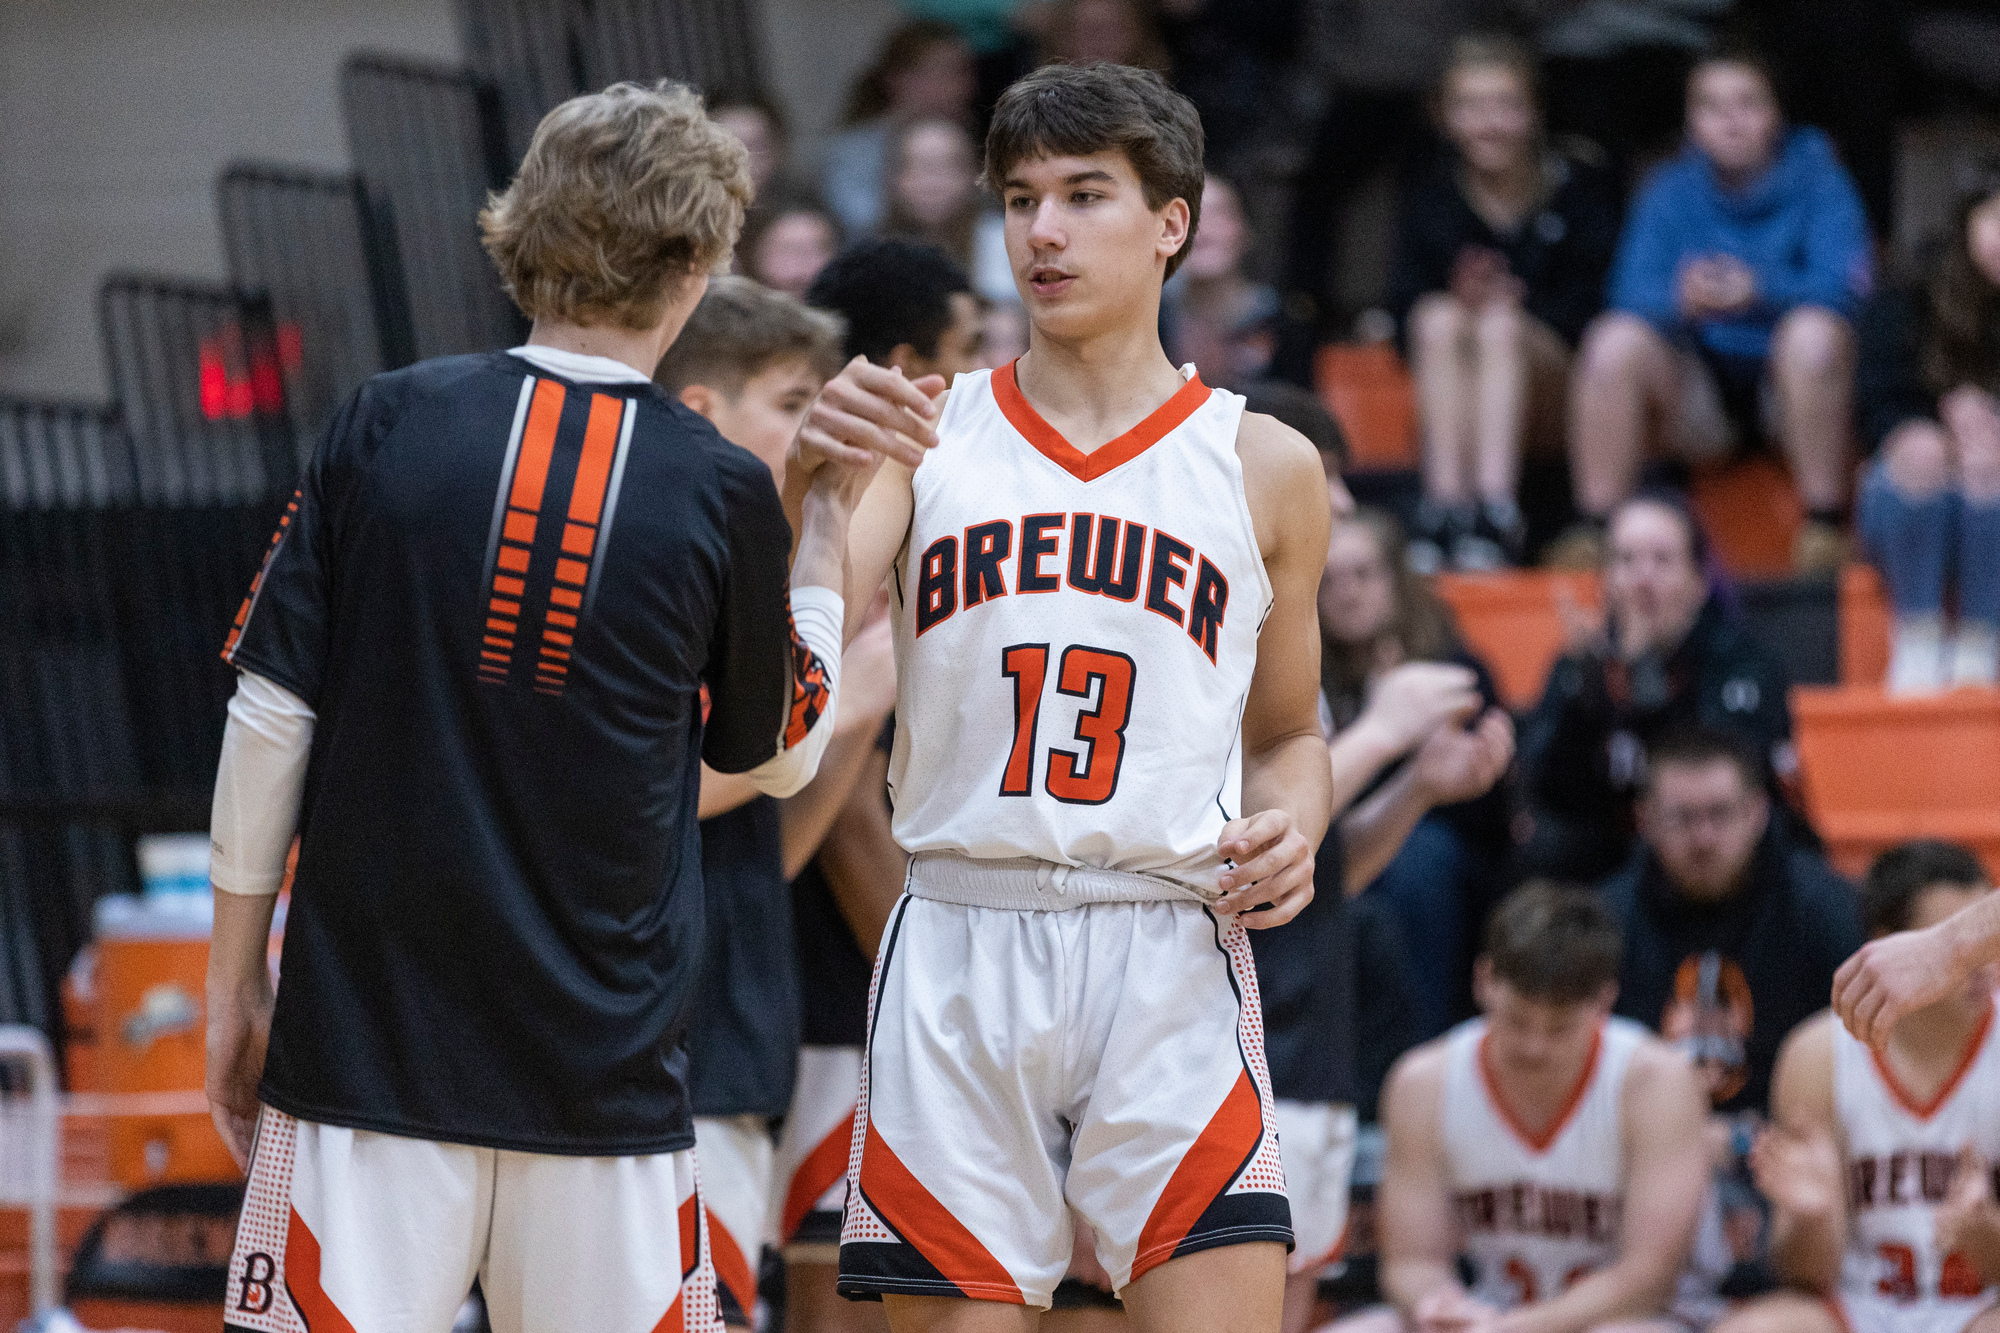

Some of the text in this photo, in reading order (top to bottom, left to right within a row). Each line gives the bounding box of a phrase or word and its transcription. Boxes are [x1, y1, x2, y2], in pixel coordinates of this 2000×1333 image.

[916, 512, 1229, 668] BREWER
[998, 642, 1137, 806] 13
[236, 1252, 276, 1315] B
